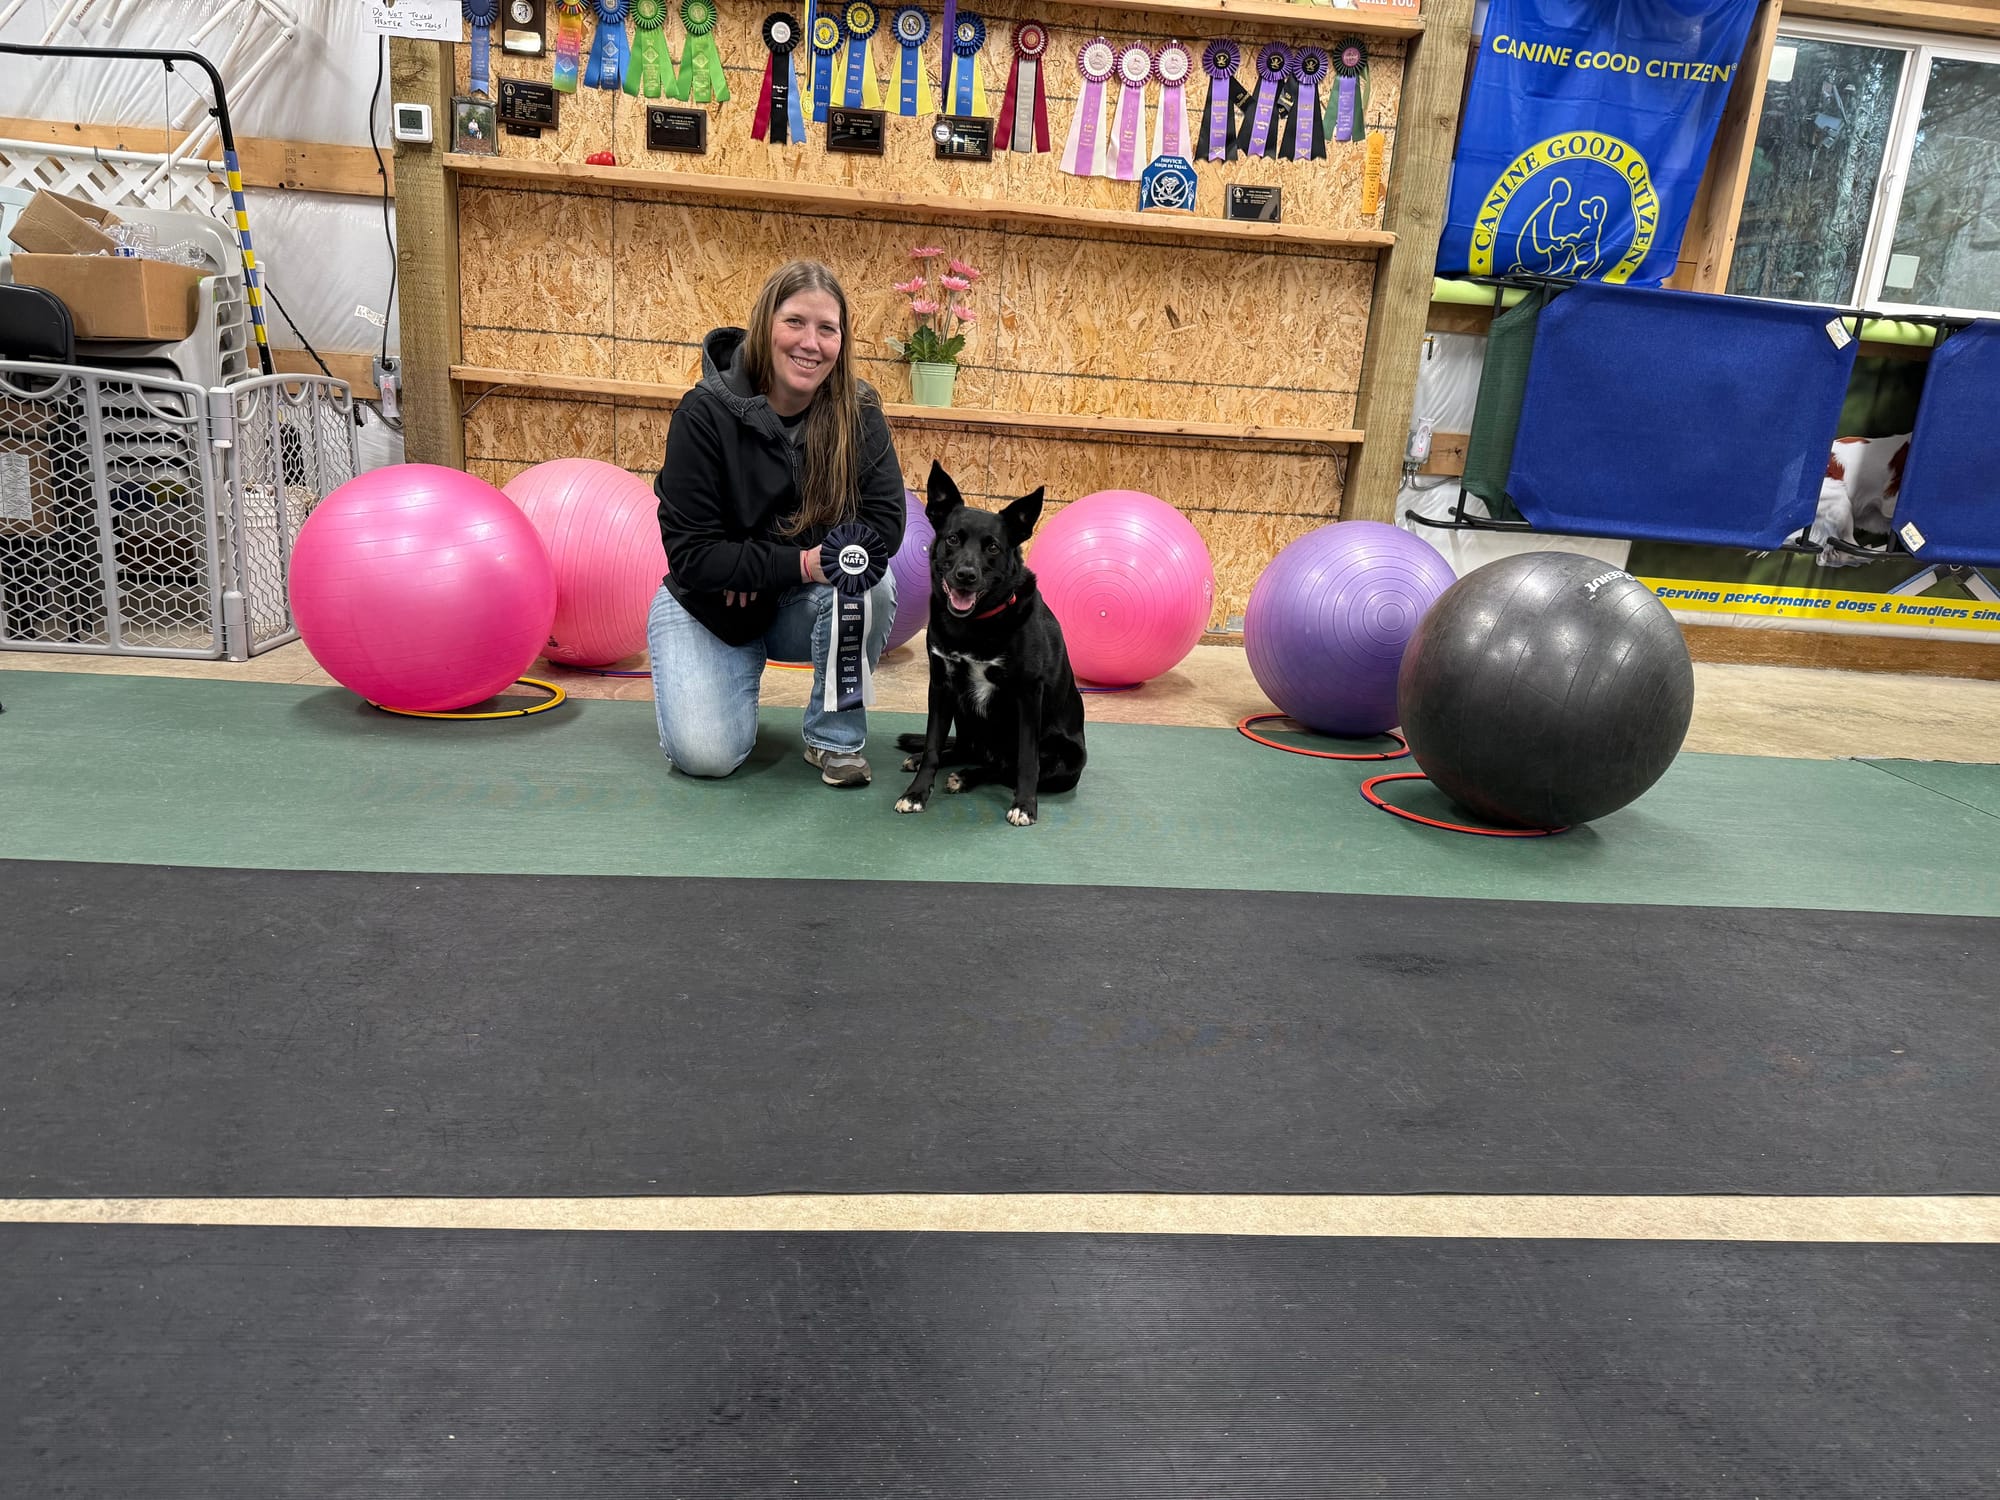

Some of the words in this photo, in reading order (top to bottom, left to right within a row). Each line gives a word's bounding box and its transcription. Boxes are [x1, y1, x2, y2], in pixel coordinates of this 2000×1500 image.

[1492, 34, 1573, 67] CANINE
[1575, 51, 1641, 74] GOOD
[1160, 157, 1183, 165] NOVICE
[1474, 151, 1541, 251] CANINE
[1547, 135, 1625, 164] GOOD
[1624, 160, 1658, 266] CITIZEN
[843, 556, 865, 565] NATE
[1656, 586, 1720, 602] Serving
[1723, 592, 1831, 609] performance
[1836, 599, 1877, 613] dogs
[1880, 602, 1891, 613] &
[1896, 603, 1969, 619] handlers
